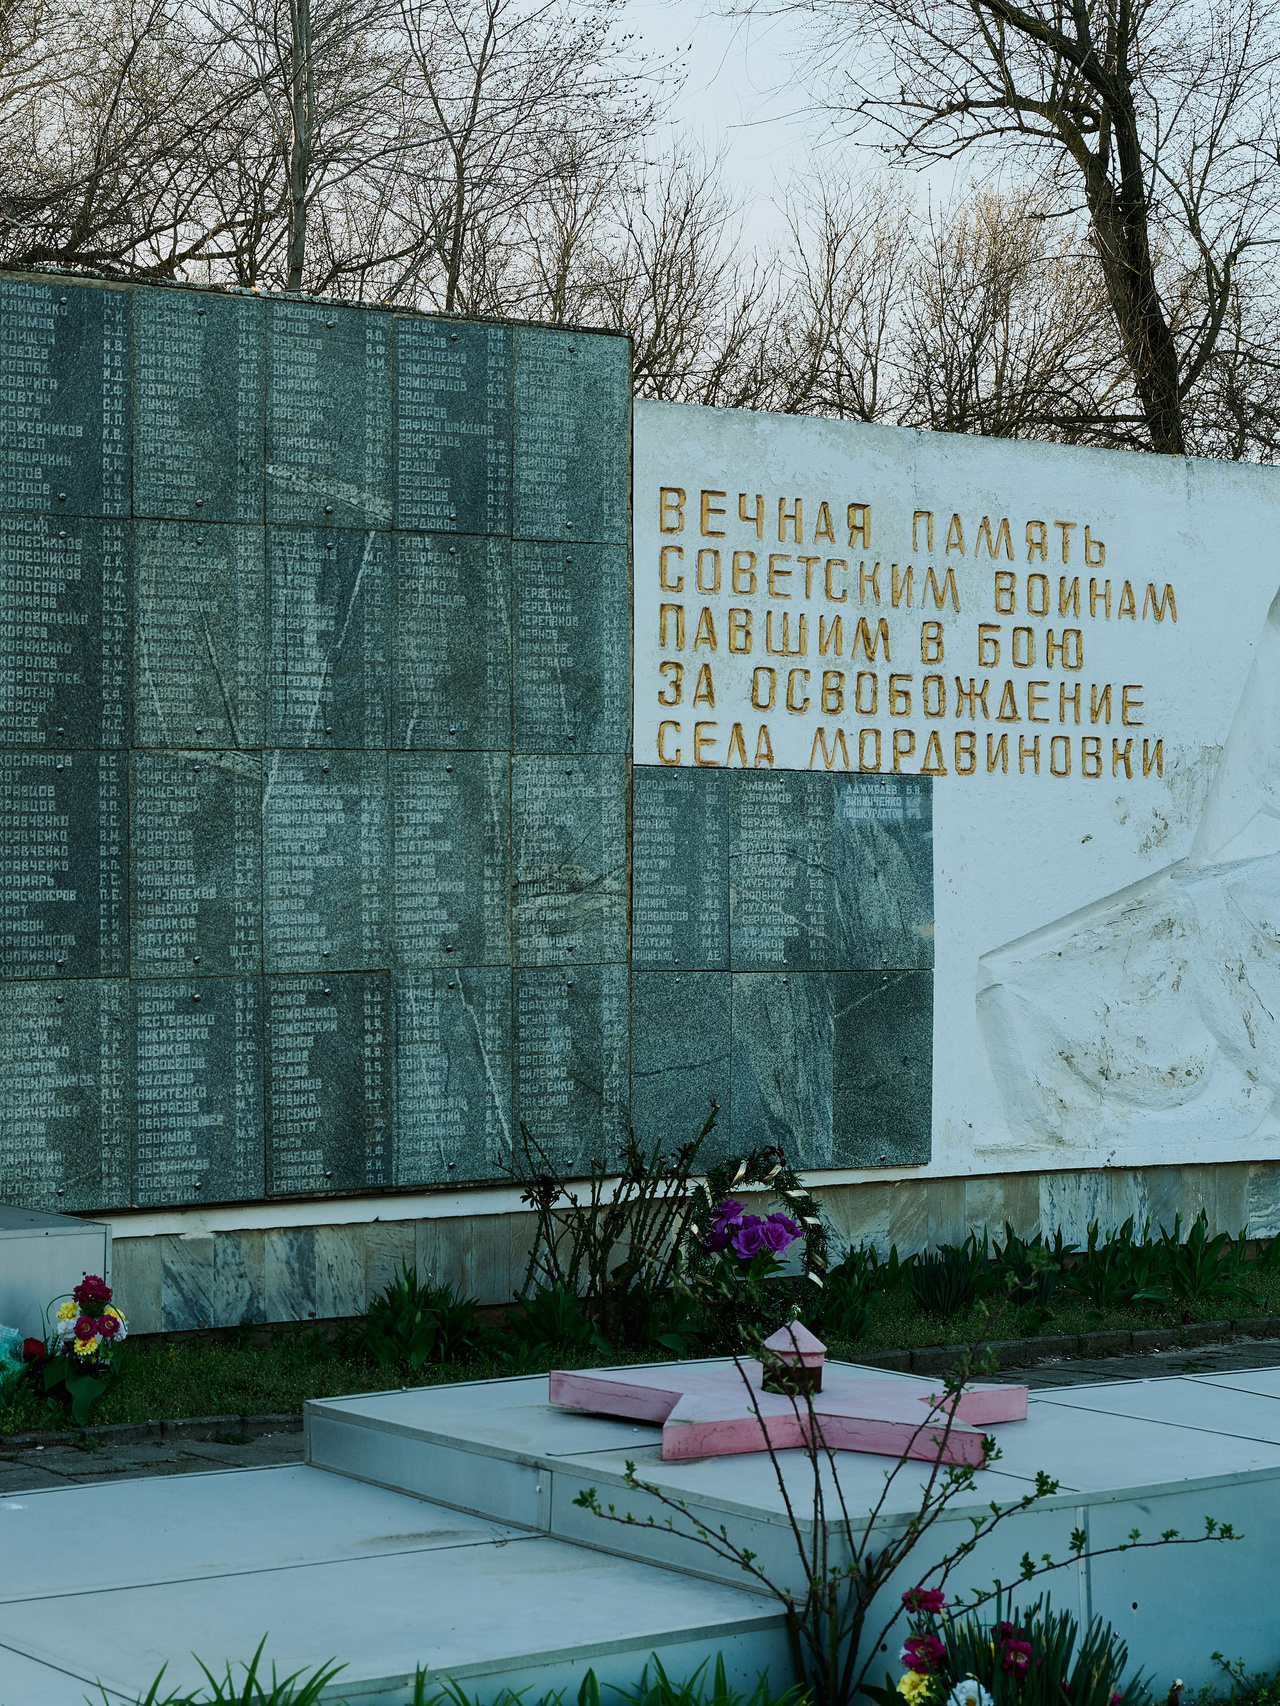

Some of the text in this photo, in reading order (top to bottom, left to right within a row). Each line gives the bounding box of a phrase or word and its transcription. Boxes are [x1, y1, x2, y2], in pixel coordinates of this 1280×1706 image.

[659, 486, 1107, 568] ВЕЧНАЯ ПАМЯТЬ
[658, 545, 1179, 623] СОВЕТСКИМ ВОИНАМ
[658, 603, 1084, 672] ПАВШИМ В БОЮ
[657, 661, 1145, 727] ЗА ОСВОБОЖДЕНИЕ
[656, 720, 1165, 780] СЕЛА МОРДВИНОВКИ
